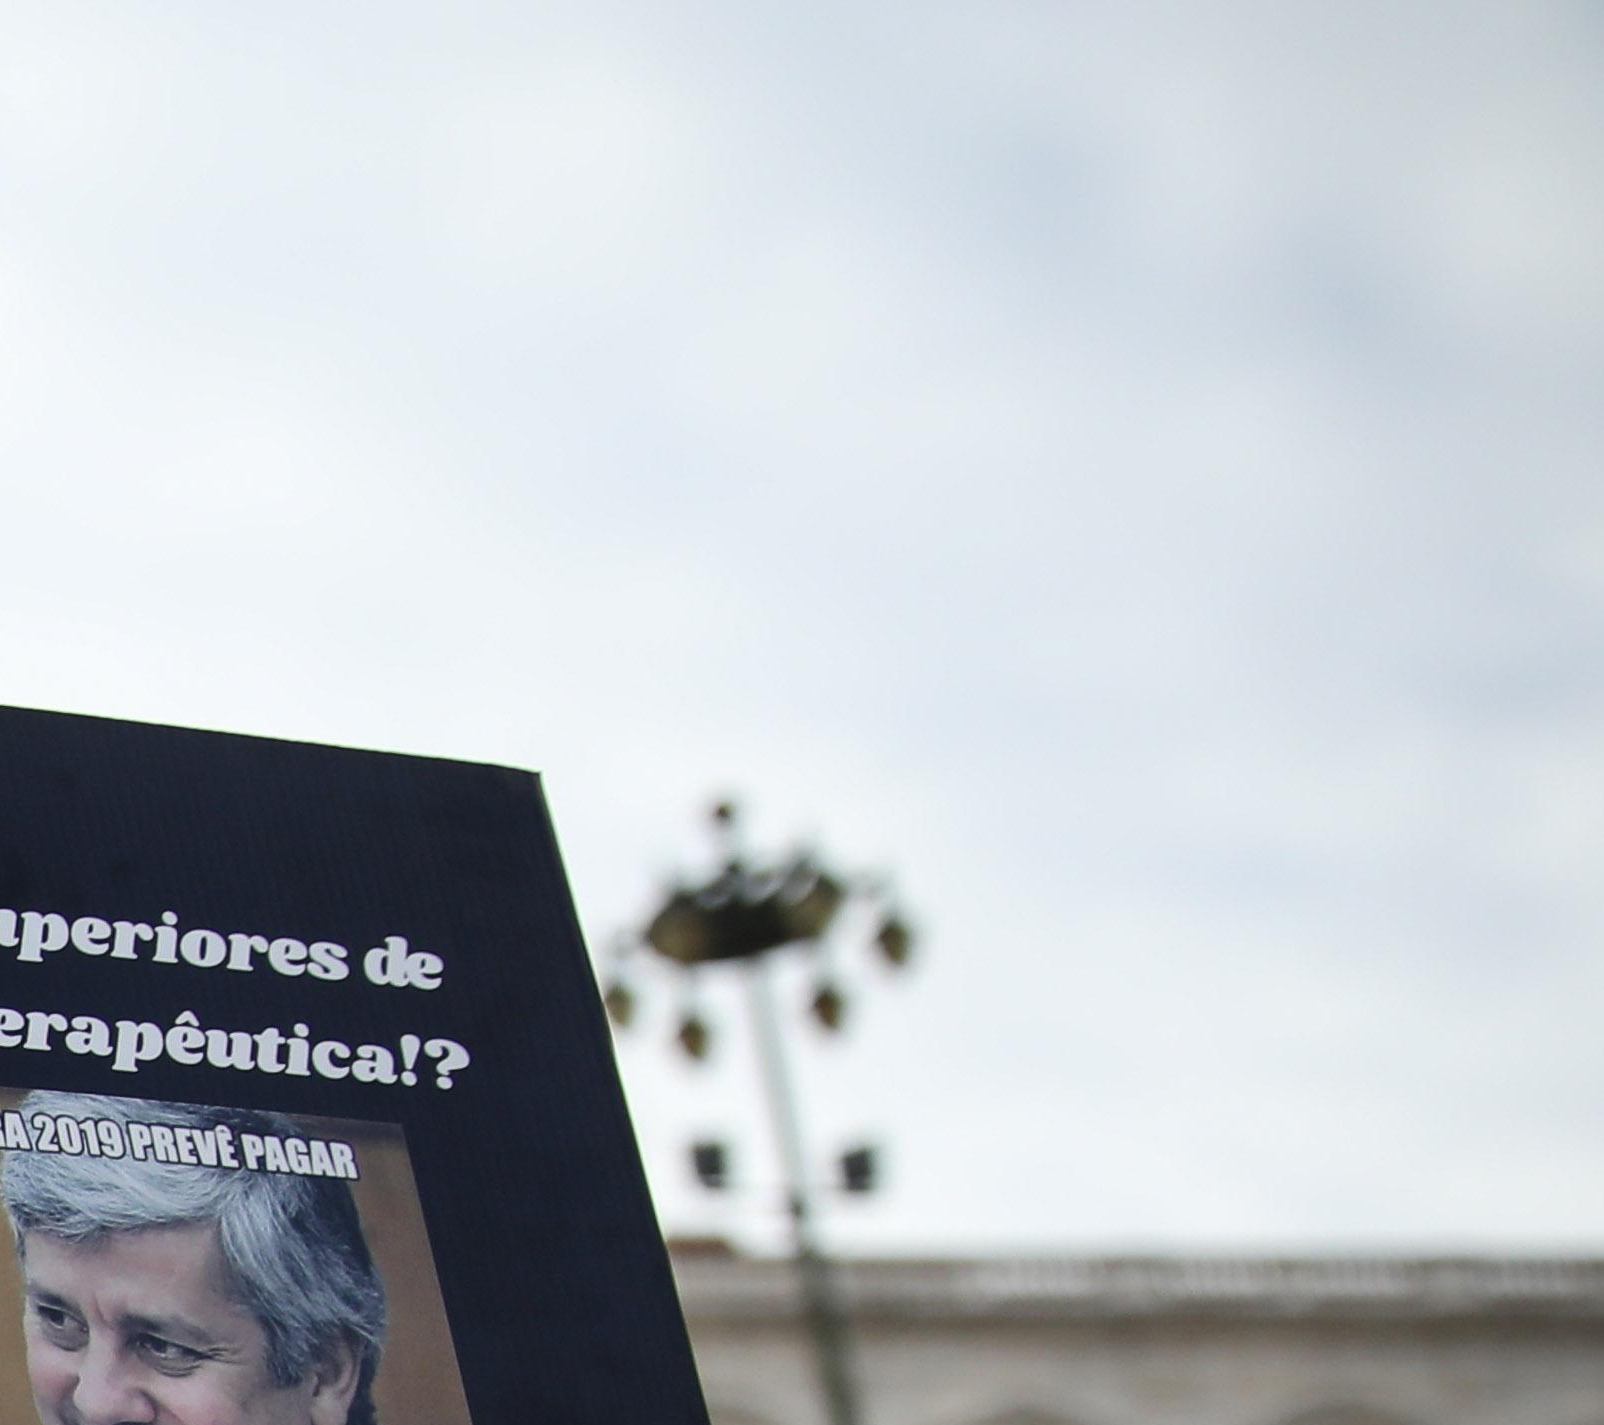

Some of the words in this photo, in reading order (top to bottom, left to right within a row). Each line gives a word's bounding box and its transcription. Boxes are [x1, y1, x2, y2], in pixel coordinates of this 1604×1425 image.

[363, 936, 444, 990] de
[30, 1115, 126, 1159] 2019
[127, 1123, 239, 1168] PREVÊ
[241, 1134, 358, 1179] PAGAR
